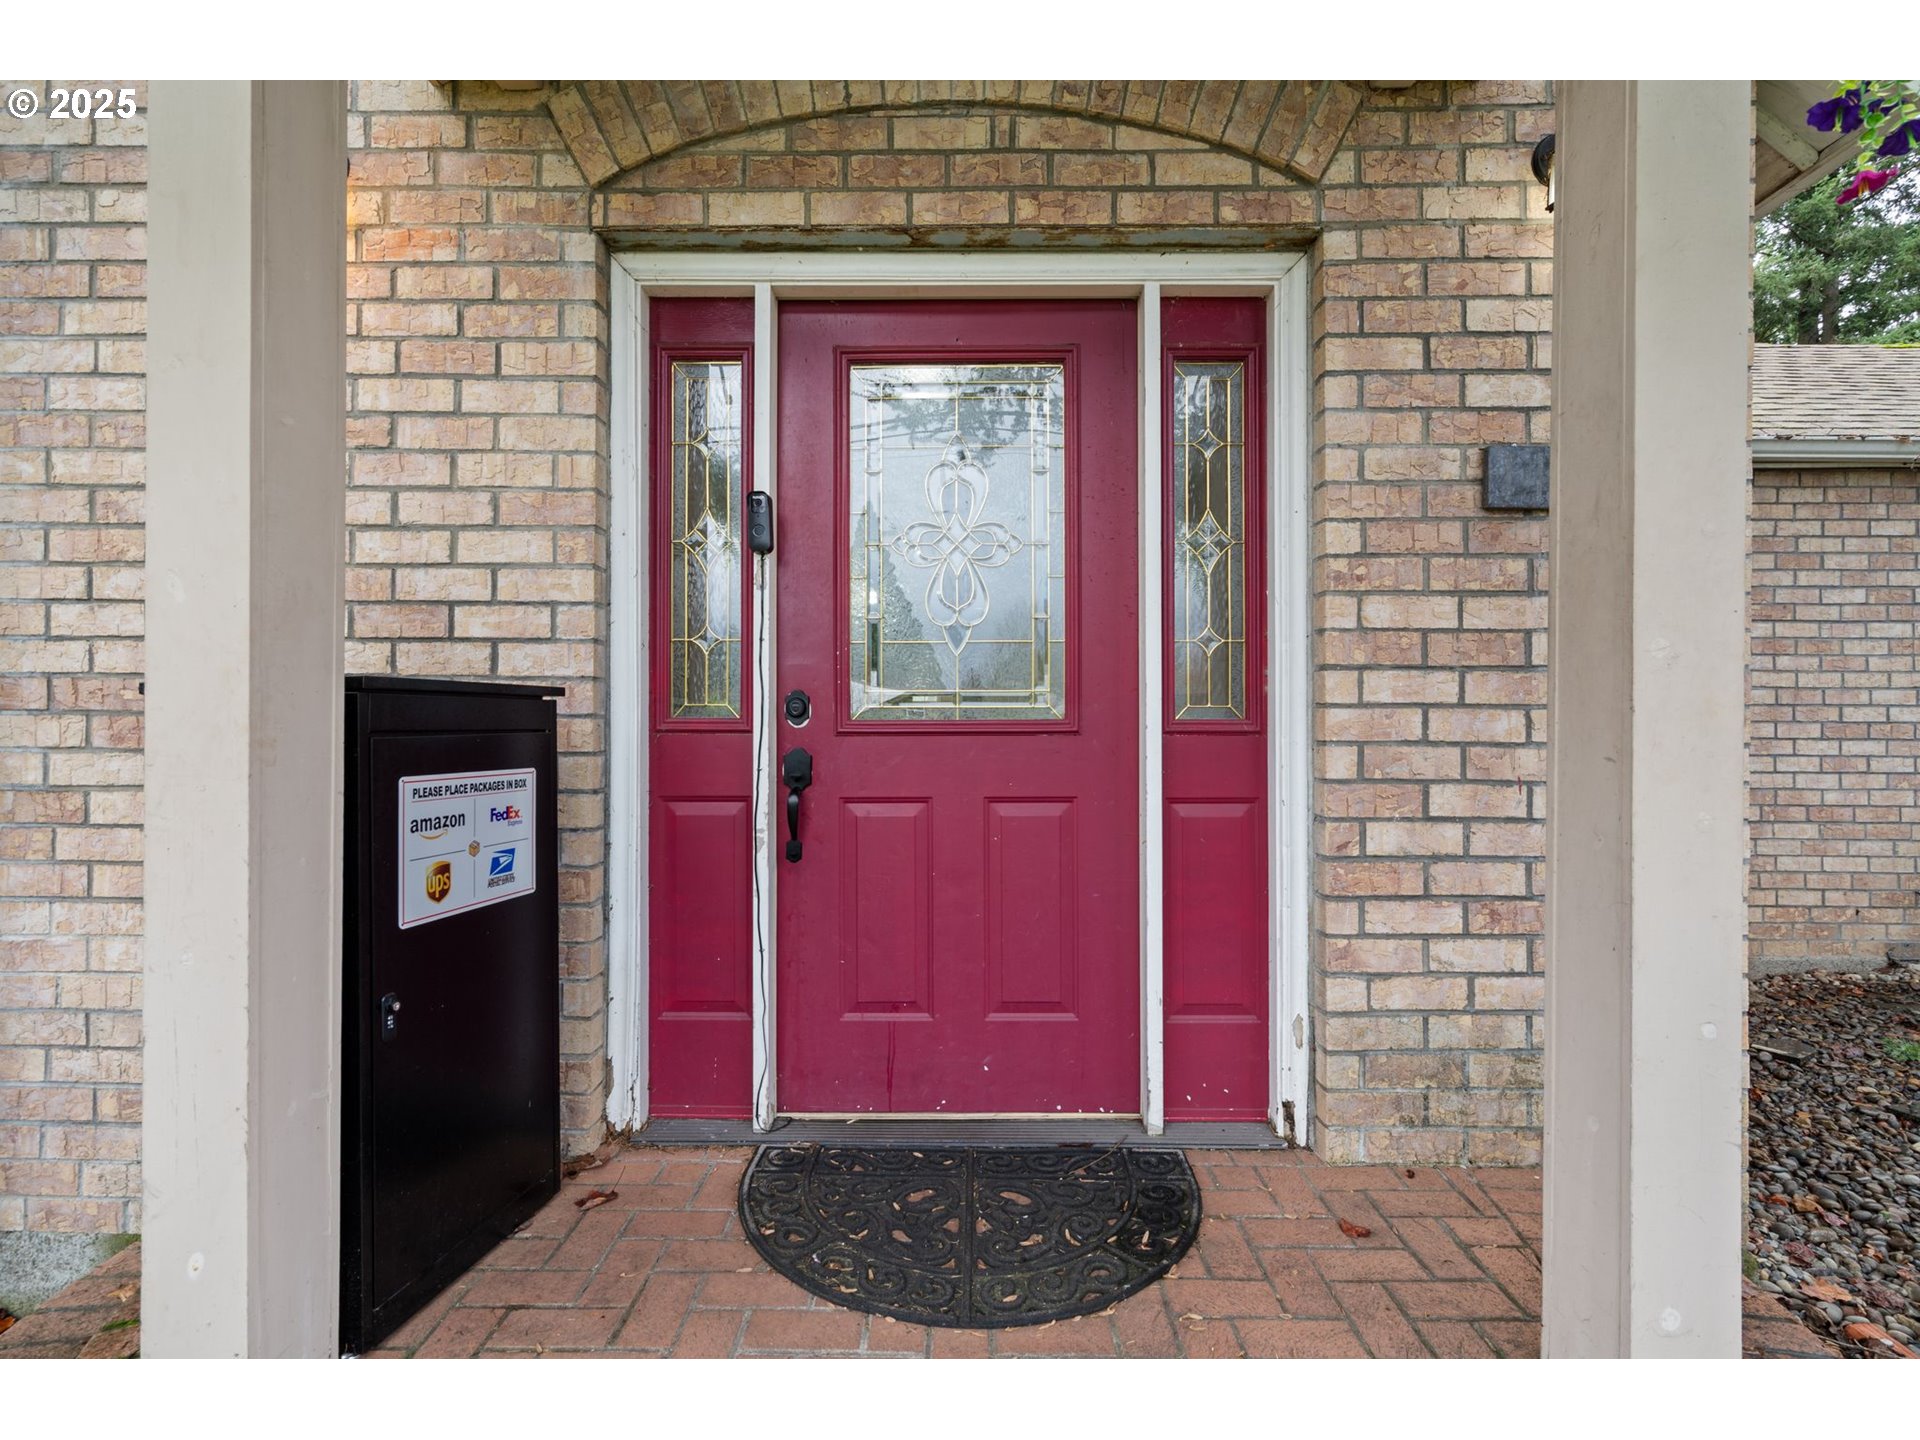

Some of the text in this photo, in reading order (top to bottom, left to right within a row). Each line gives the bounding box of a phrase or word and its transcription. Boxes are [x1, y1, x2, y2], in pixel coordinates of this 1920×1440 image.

[412, 778, 527, 799] PLEASE PLACE PACKAGES IN BOX
[410, 813, 465, 833] amazon
[490, 805, 520, 822] FedEx
[428, 872, 450, 898] ups
